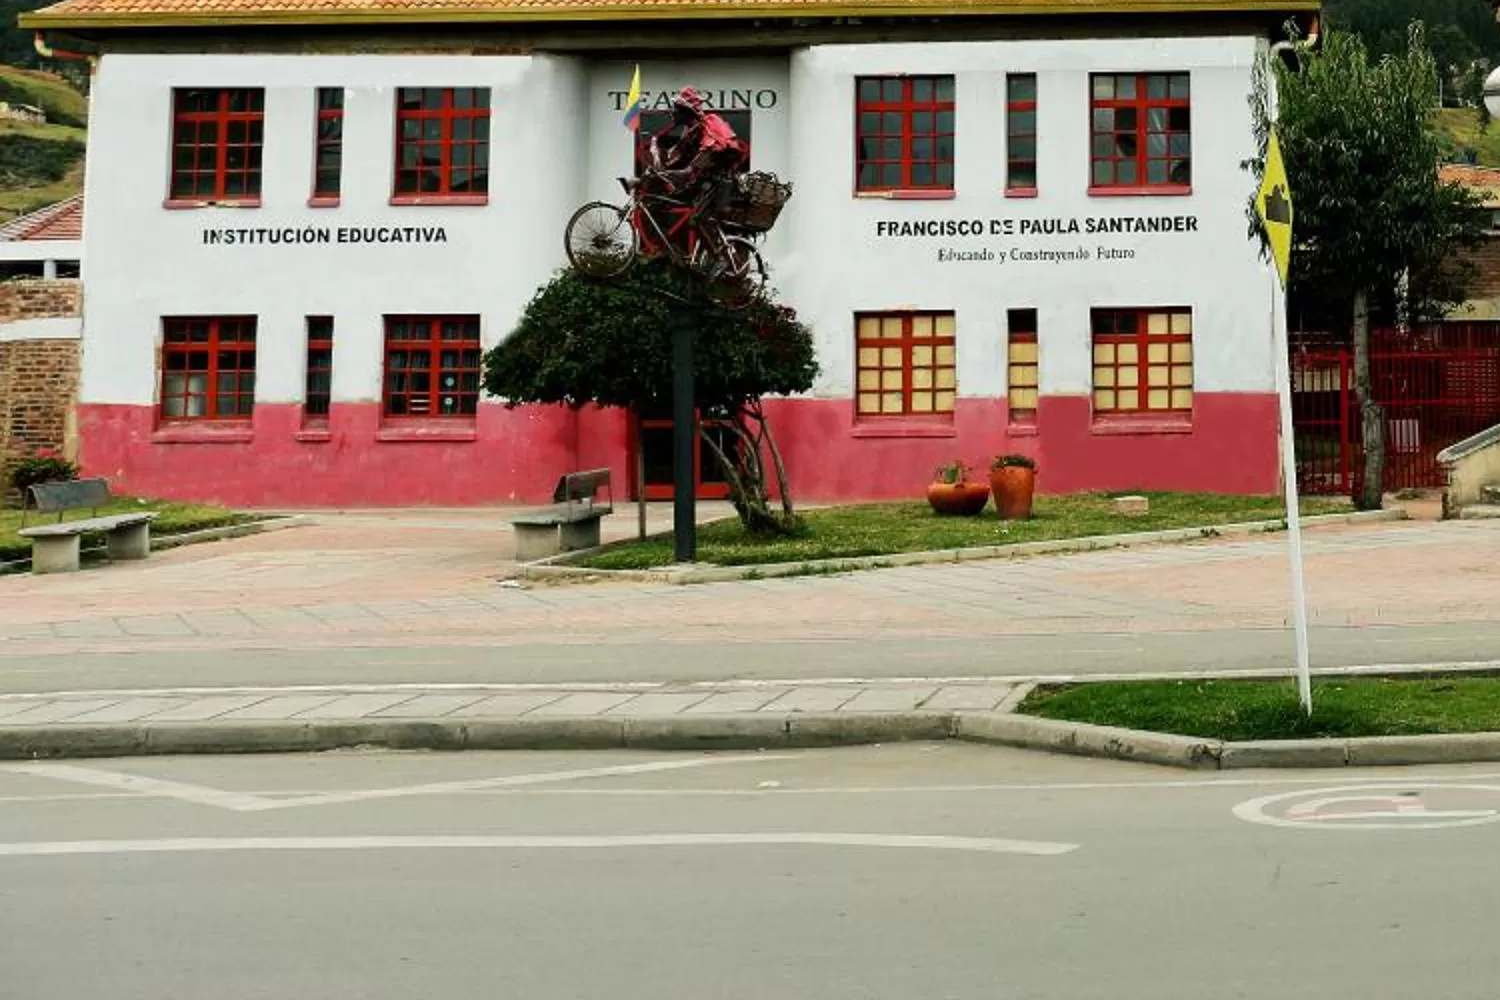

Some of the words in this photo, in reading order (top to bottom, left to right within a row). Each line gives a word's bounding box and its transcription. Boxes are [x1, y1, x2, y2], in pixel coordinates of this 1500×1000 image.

[203, 226, 331, 245] INSTITUCIÓN
[336, 227, 448, 244] EDUCATIVA
[876, 220, 983, 237] FRANCISCO
[990, 219, 1013, 235] DE
[1019, 218, 1080, 235] PAULA
[1085, 215, 1199, 233] SANTANDER
[938, 247, 995, 262] Educando
[999, 251, 1007, 265] y
[1009, 246, 1090, 265] Construyendo
[1097, 245, 1136, 260] Futuro
